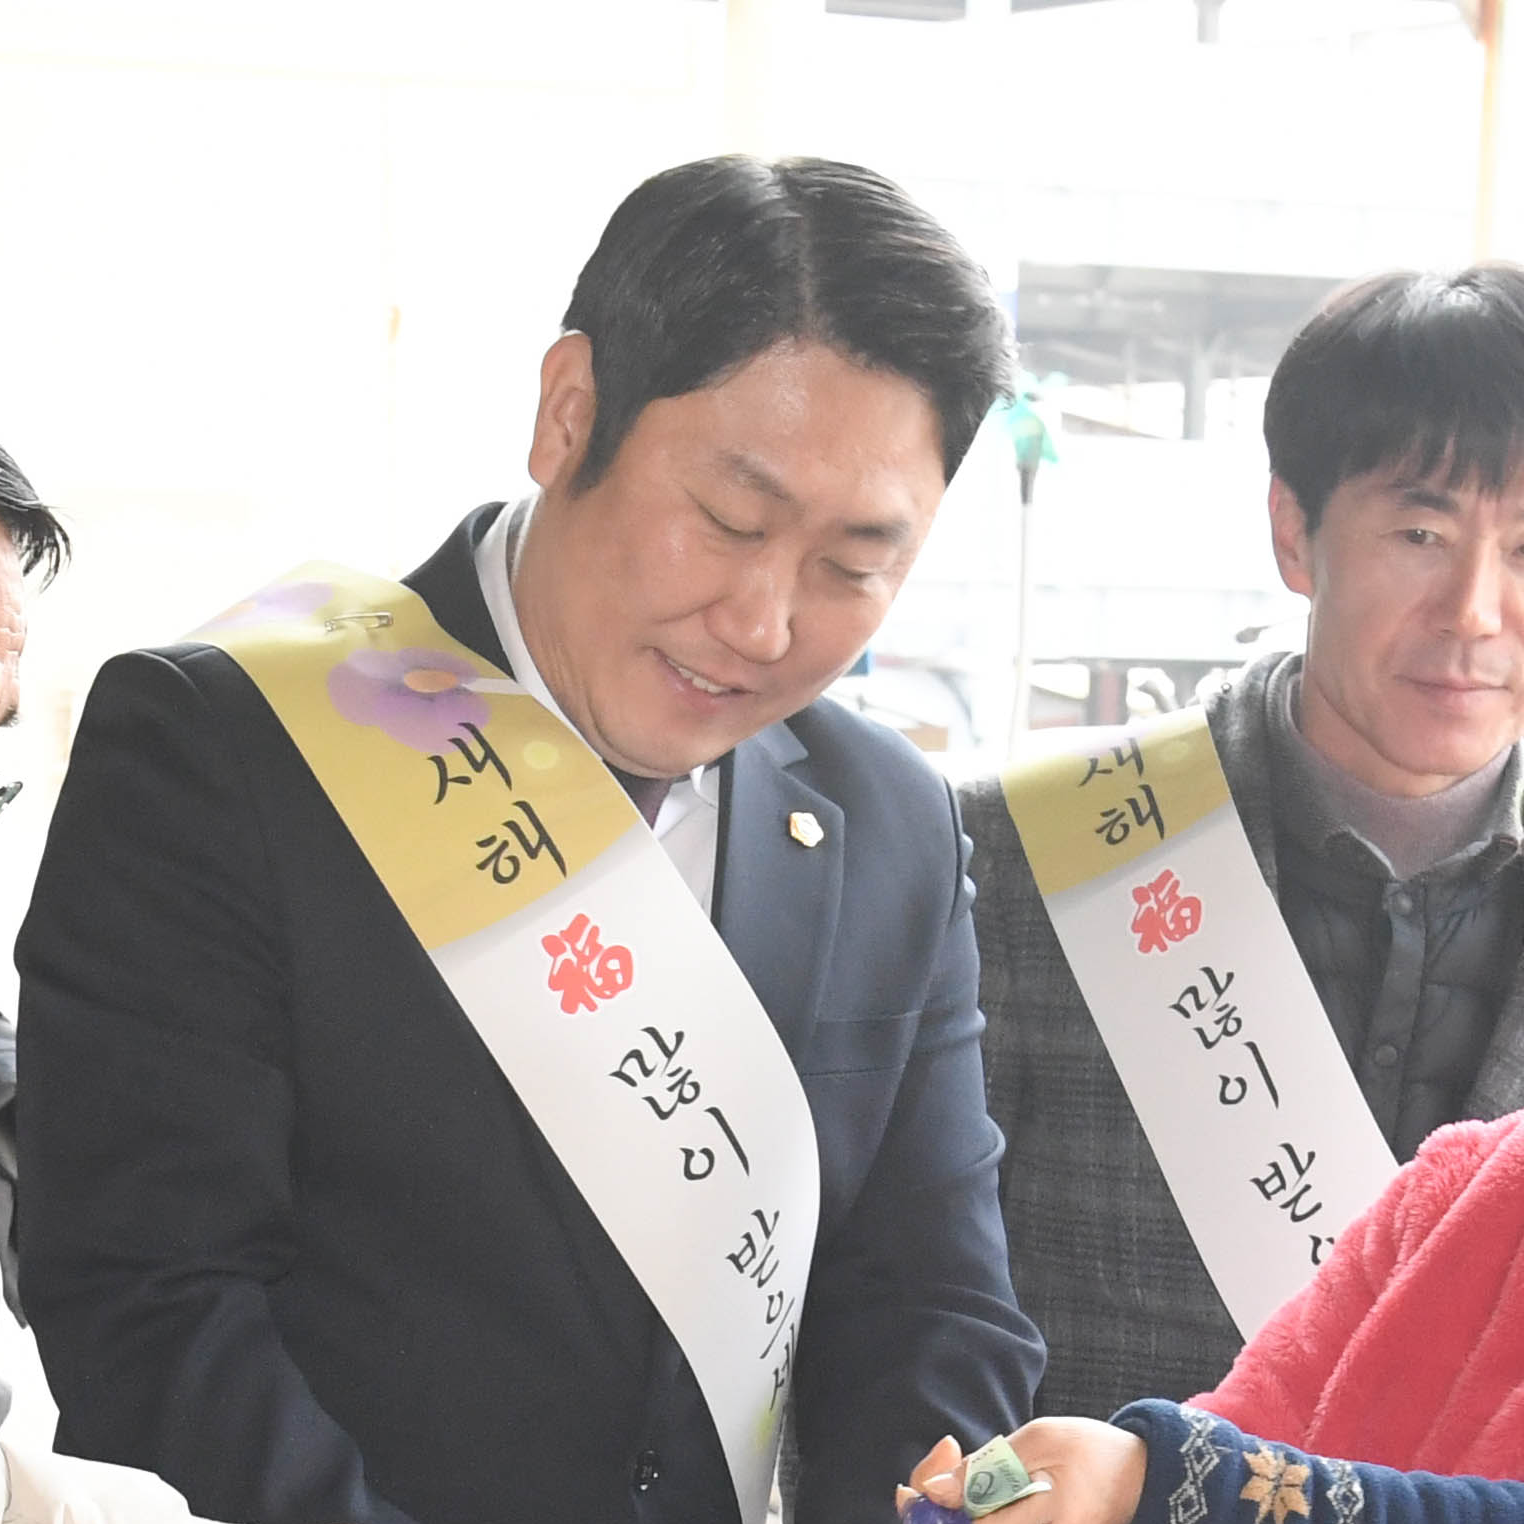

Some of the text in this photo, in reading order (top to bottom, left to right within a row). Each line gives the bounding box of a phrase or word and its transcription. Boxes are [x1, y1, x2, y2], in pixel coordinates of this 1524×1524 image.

[428, 722, 567, 885] 새해
[541, 912, 635, 1015] 福
[608, 1026, 750, 1181] 많이
[1078, 737, 1165, 845] 새해
[1131, 869, 1203, 954] 福
[1168, 966, 1279, 1110] 많이
